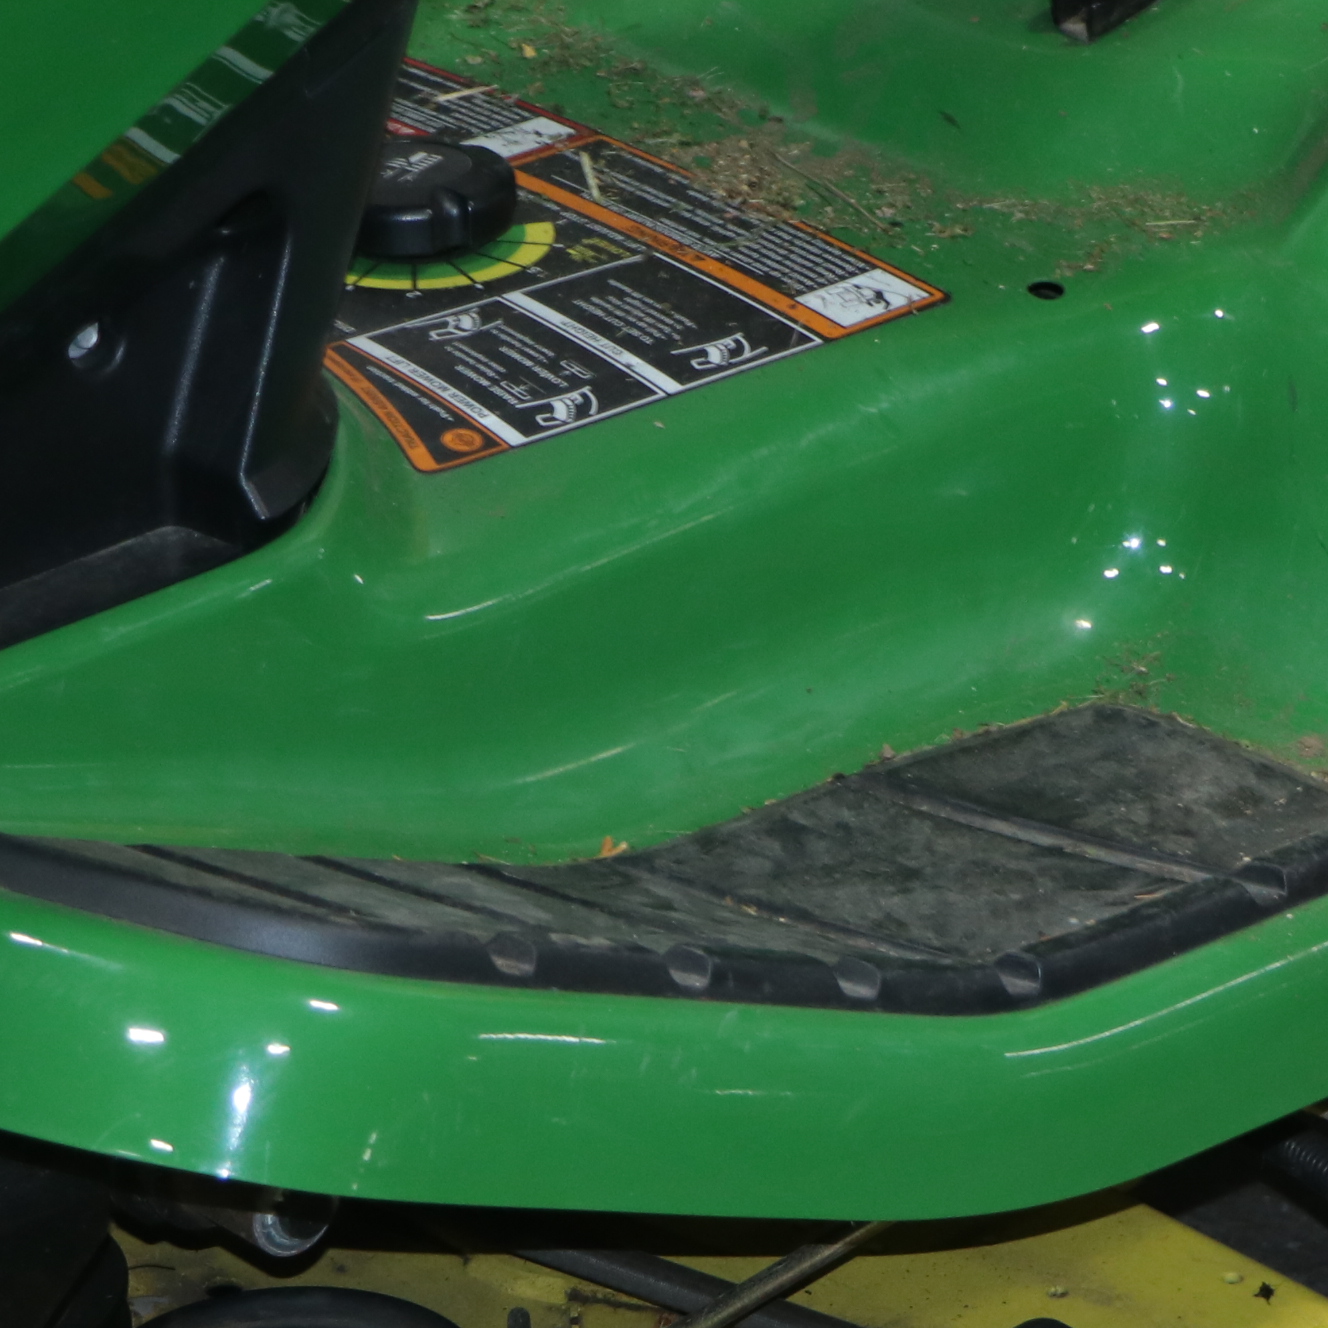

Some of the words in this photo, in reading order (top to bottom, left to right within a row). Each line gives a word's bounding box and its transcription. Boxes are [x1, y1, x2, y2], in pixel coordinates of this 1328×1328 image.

[560, 320, 601, 341] HEIGHT
[385, 353, 412, 368] LIFT
[409, 365, 450, 392] MOWER
[448, 391, 487, 419] POWER
